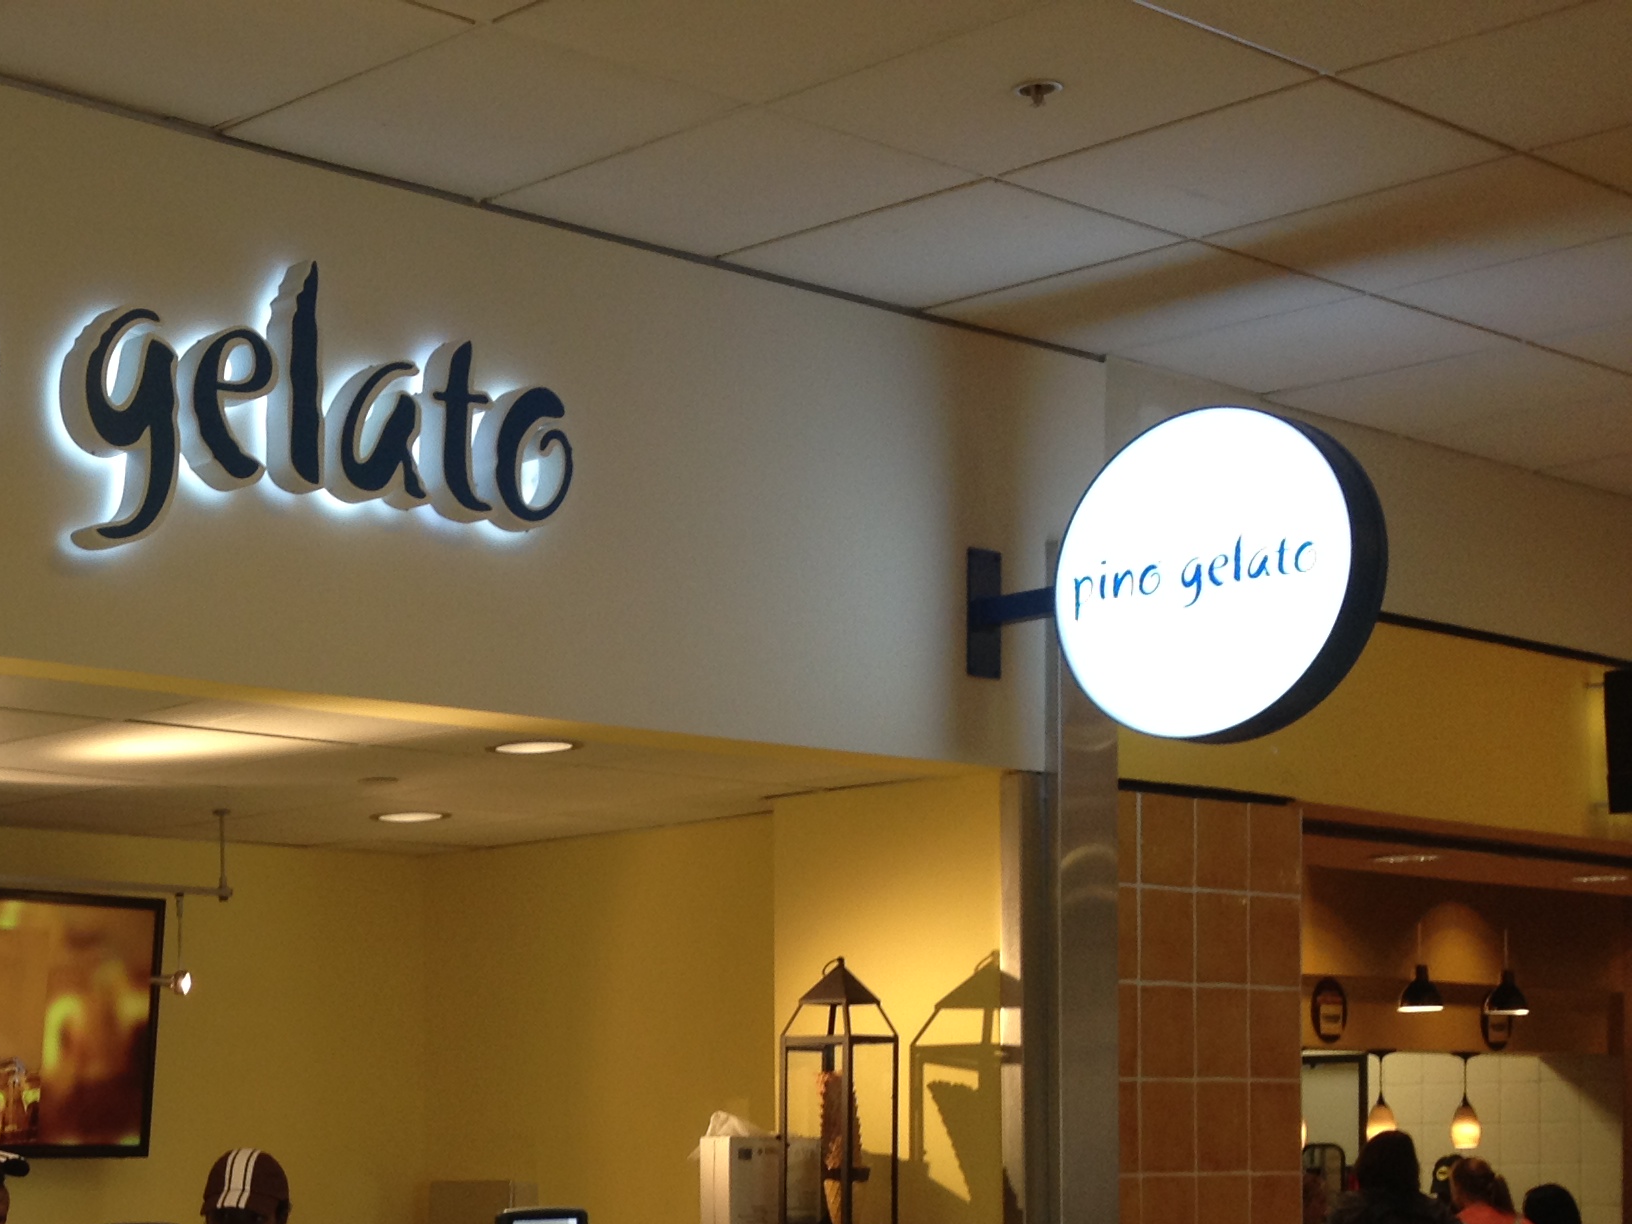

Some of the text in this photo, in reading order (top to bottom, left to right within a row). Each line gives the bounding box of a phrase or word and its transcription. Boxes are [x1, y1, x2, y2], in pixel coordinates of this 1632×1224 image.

[63, 260, 574, 549] gelato
[1073, 533, 1318, 621] pino gelato
